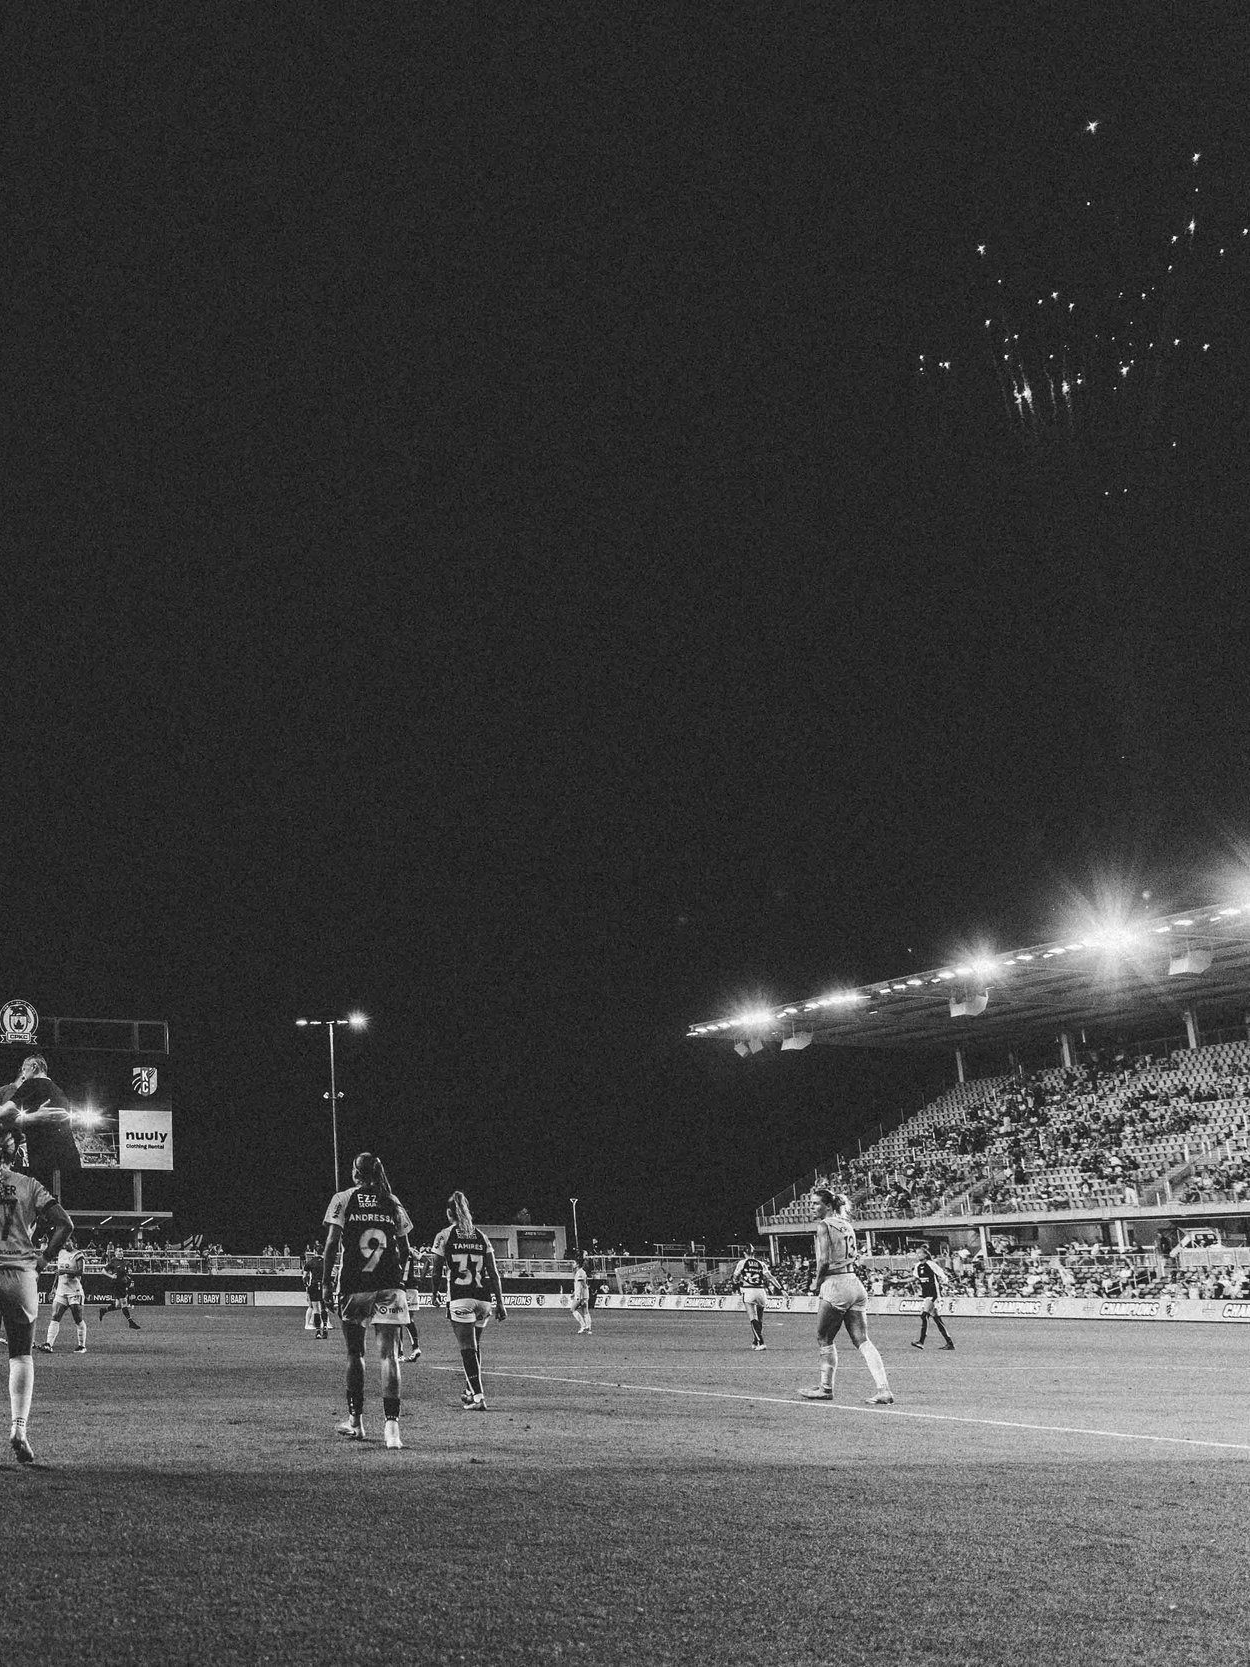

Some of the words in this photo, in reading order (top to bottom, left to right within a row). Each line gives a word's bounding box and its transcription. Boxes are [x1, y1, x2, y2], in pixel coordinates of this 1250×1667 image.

[126, 1131, 168, 1143] nuuly
[357, 1193, 378, 1203] EZZ
[359, 1228, 387, 1272] 9
[453, 1243, 483, 1251] TAMIRES
[844, 1235, 855, 1259] 13
[451, 1254, 484, 1288] 37
[175, 1294, 192, 1303] BABY
[203, 1294, 220, 1303] BABY
[230, 1294, 247, 1303] BABY
[990, 1300, 1042, 1314] CHAMPIONS
[1100, 1301, 1160, 1316] CHAMPIONS
